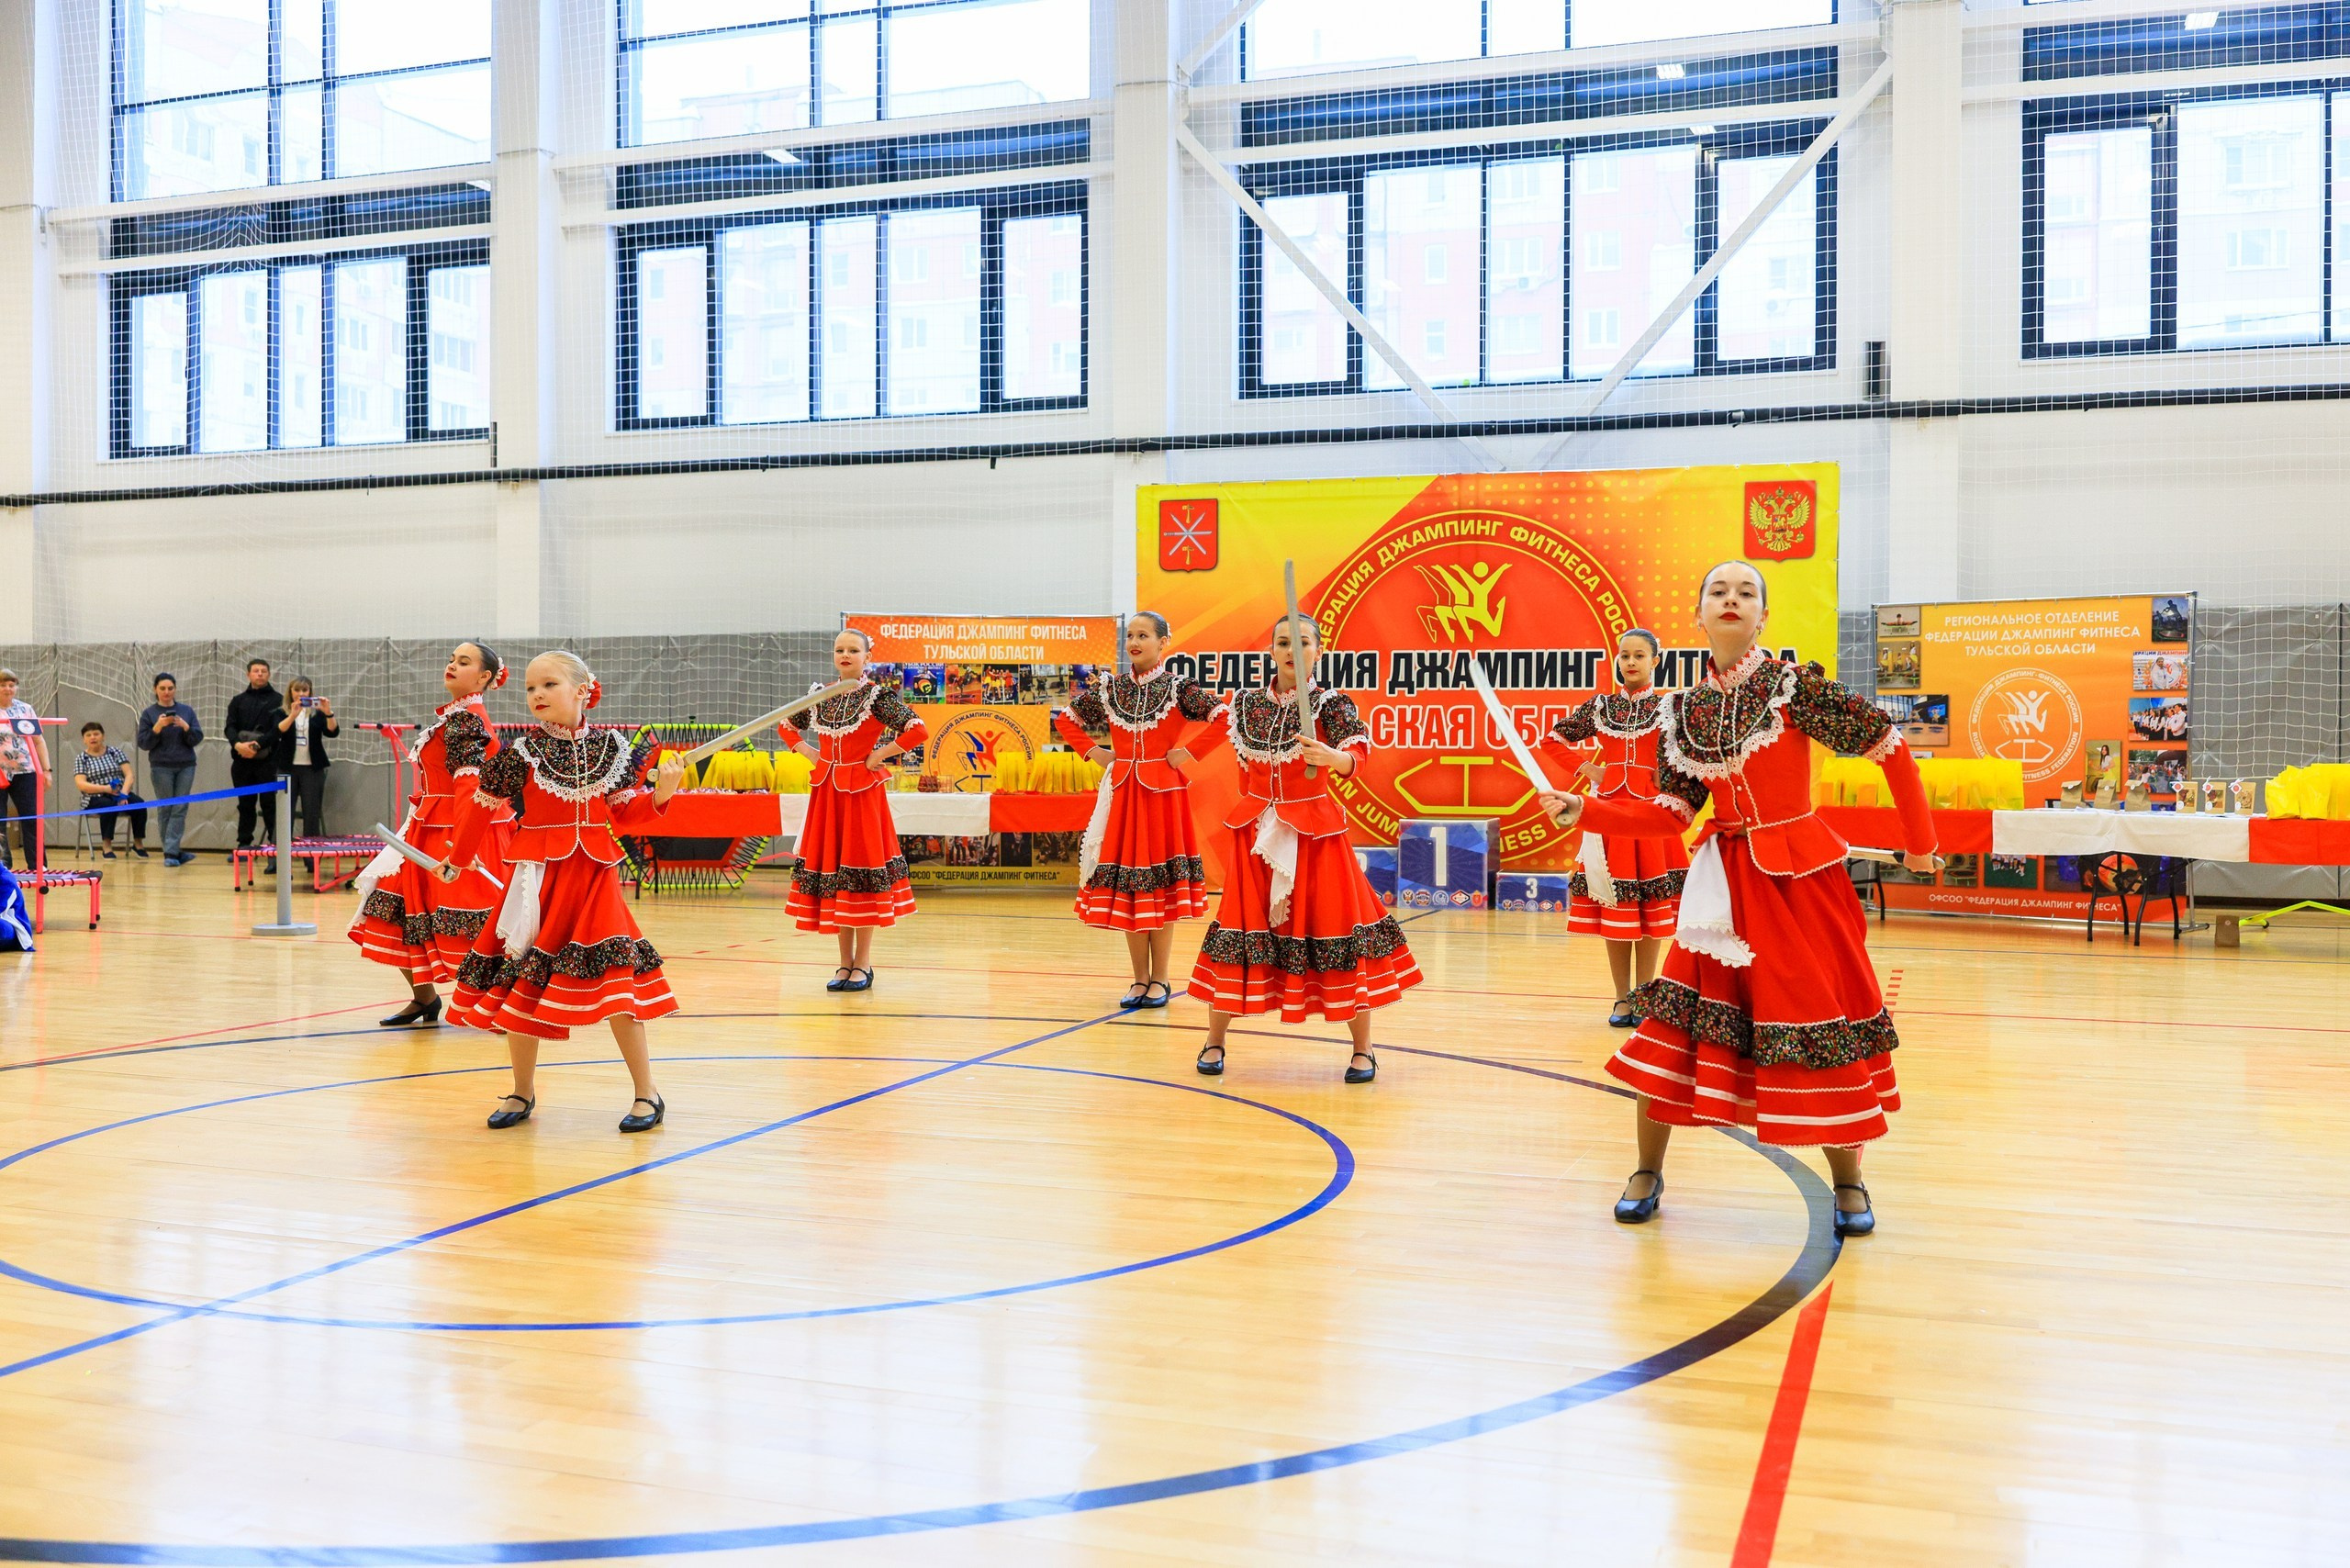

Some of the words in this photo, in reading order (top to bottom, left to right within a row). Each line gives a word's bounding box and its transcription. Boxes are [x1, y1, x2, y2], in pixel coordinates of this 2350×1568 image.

[1319, 560, 1375, 651] ЕРАЦИЯ
[1377, 520, 1503, 567] ДЖАМПИНГ
[1510, 526, 1601, 592] ФИТНЕСА
[1596, 590, 1628, 645] РОС
[1944, 613, 2042, 627] РЕГИОНАЛЬНОЕ
[2044, 610, 2119, 625] ОТДЕЛЕНИЕ
[879, 623, 954, 641] ФЕДЕРАЦИЯ
[957, 624, 1027, 641] ДЖАМПИНГ
[1030, 625, 1087, 641] ФИТНЕСА
[1924, 629, 1998, 643] ФЕДЕРАЦИИ
[2000, 627, 2076, 642] ДЖАМПИНГ
[2079, 626, 2140, 639] ФИТНЕСА
[923, 644, 987, 660] ТУЛЬСКОЙ
[989, 645, 1045, 661] ОБЛАСТИ
[1965, 642, 2031, 657] ТУЛЬСКОЙ
[2034, 643, 2096, 655] ОБЛАСТИ
[1163, 651, 1379, 696] ФЕДЕРЦИЯ
[1387, 648, 1606, 697] ДЖАМПИНГ
[932, 722, 955, 760] ФЕДЕРАЦИЯ
[955, 711, 993, 725] ДЖАМПИНГ
[994, 714, 1021, 735] ФИТНЕСА
[1020, 734, 1033, 760] РОССИИ
[1429, 827, 1447, 887] 1
[933, 871, 979, 881] "ФЕДЕРАЦИЯ
[980, 871, 1022, 881] ДЖАМПИНГ
[1024, 871, 1060, 880] ФИТНЕСА"
[1526, 878, 1538, 899] 3
[1929, 893, 1963, 903] ОФСОО
[1965, 895, 2019, 907] "ФЕДЕРАЦИЯ
[2020, 898, 2072, 909] ДЖАМПИНГ
[2076, 901, 2121, 912] ФИНЕСА"
